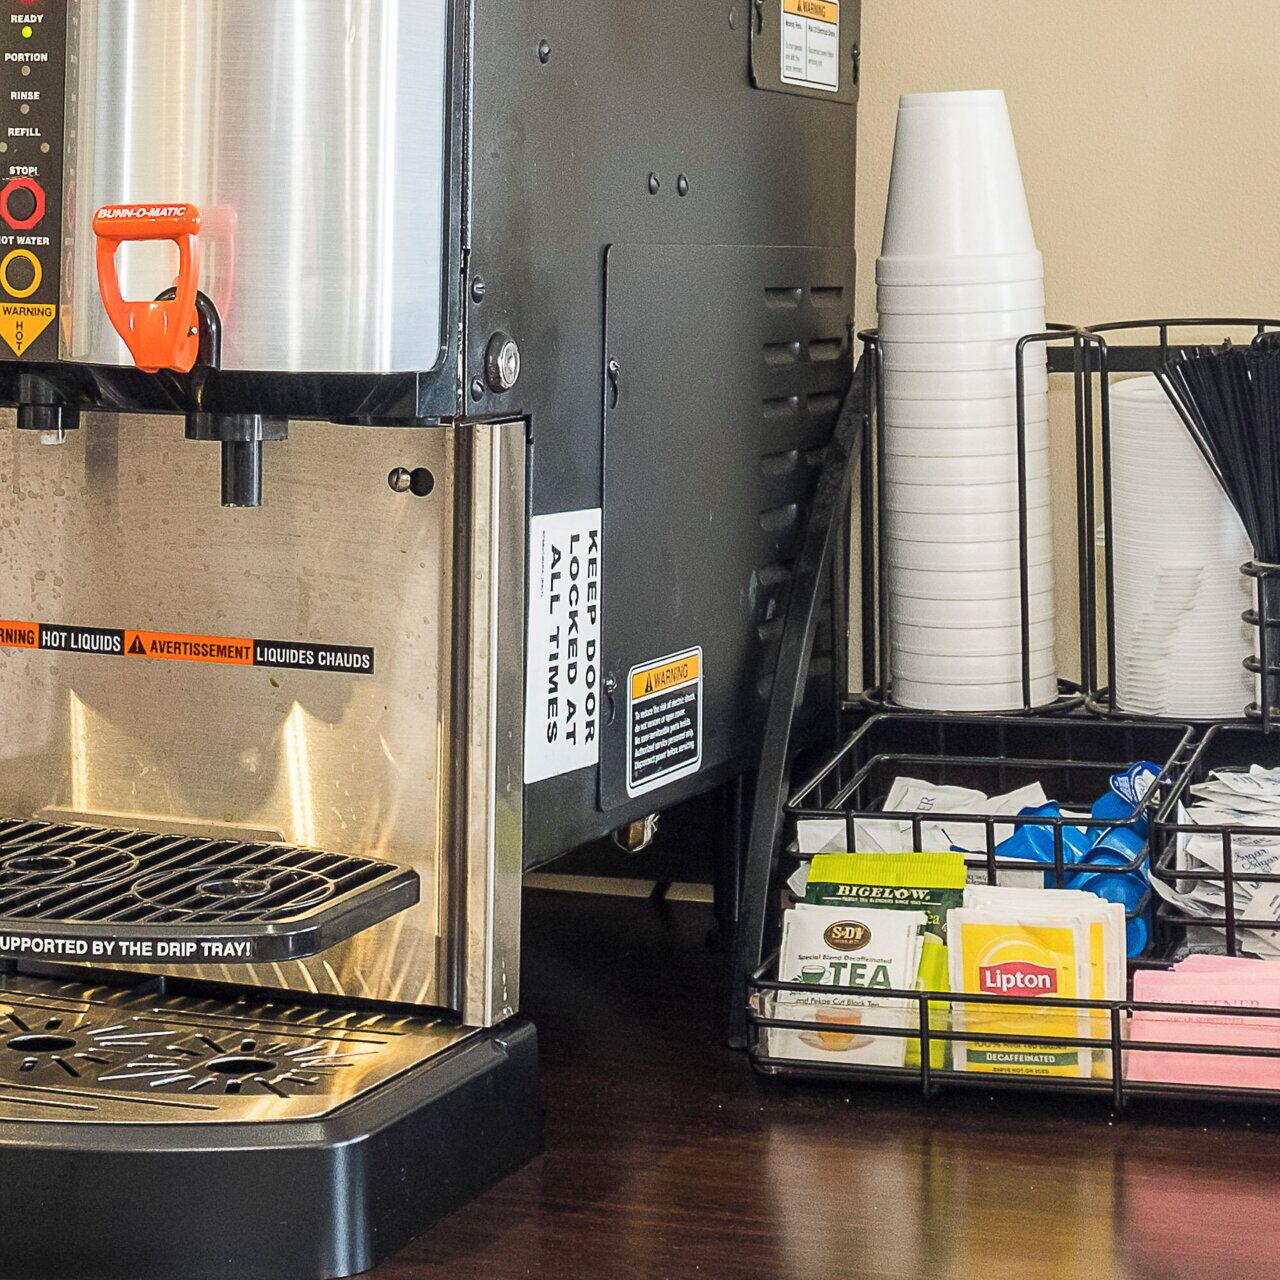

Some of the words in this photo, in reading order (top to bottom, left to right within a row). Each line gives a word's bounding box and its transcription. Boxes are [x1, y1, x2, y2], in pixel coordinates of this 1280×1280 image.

[11, 14, 44, 23] READY
[5, 52, 48, 62] PORTION
[11, 91, 40, 100] RINSE
[8, 127, 41, 137] REFILL
[98, 207, 187, 219] BUNN-O-MATIC
[16, 236, 50, 246] WATER
[2, 306, 52, 317] WARNING
[15, 321, 24, 351] HOT
[549, 544, 562, 615] ALL
[587, 530, 598, 625] KEEP
[567, 534, 580, 685] LOCKED
[42, 631, 67, 648] HOT
[70, 632, 121, 652] LIQUIDS
[150, 639, 251, 660] AVERTISSEMENT
[256, 646, 314, 665] LIQUIDES
[318, 651, 371, 669] CHAUDS
[547, 626, 561, 744] TIMES
[653, 663, 689, 690] WARNING
[585, 639, 597, 744] DOOR
[565, 698, 577, 746] AT
[836, 885, 929, 900] BIGELOW
[92, 940, 115, 956] BY
[119, 940, 153, 956] THE
[157, 941, 197, 957] DRIP
[201, 942, 252, 957] TRAY!
[829, 962, 892, 990] TEA
[985, 970, 1051, 992] Lipton
[986, 1052, 1056, 1063] DECAFFEINATED
